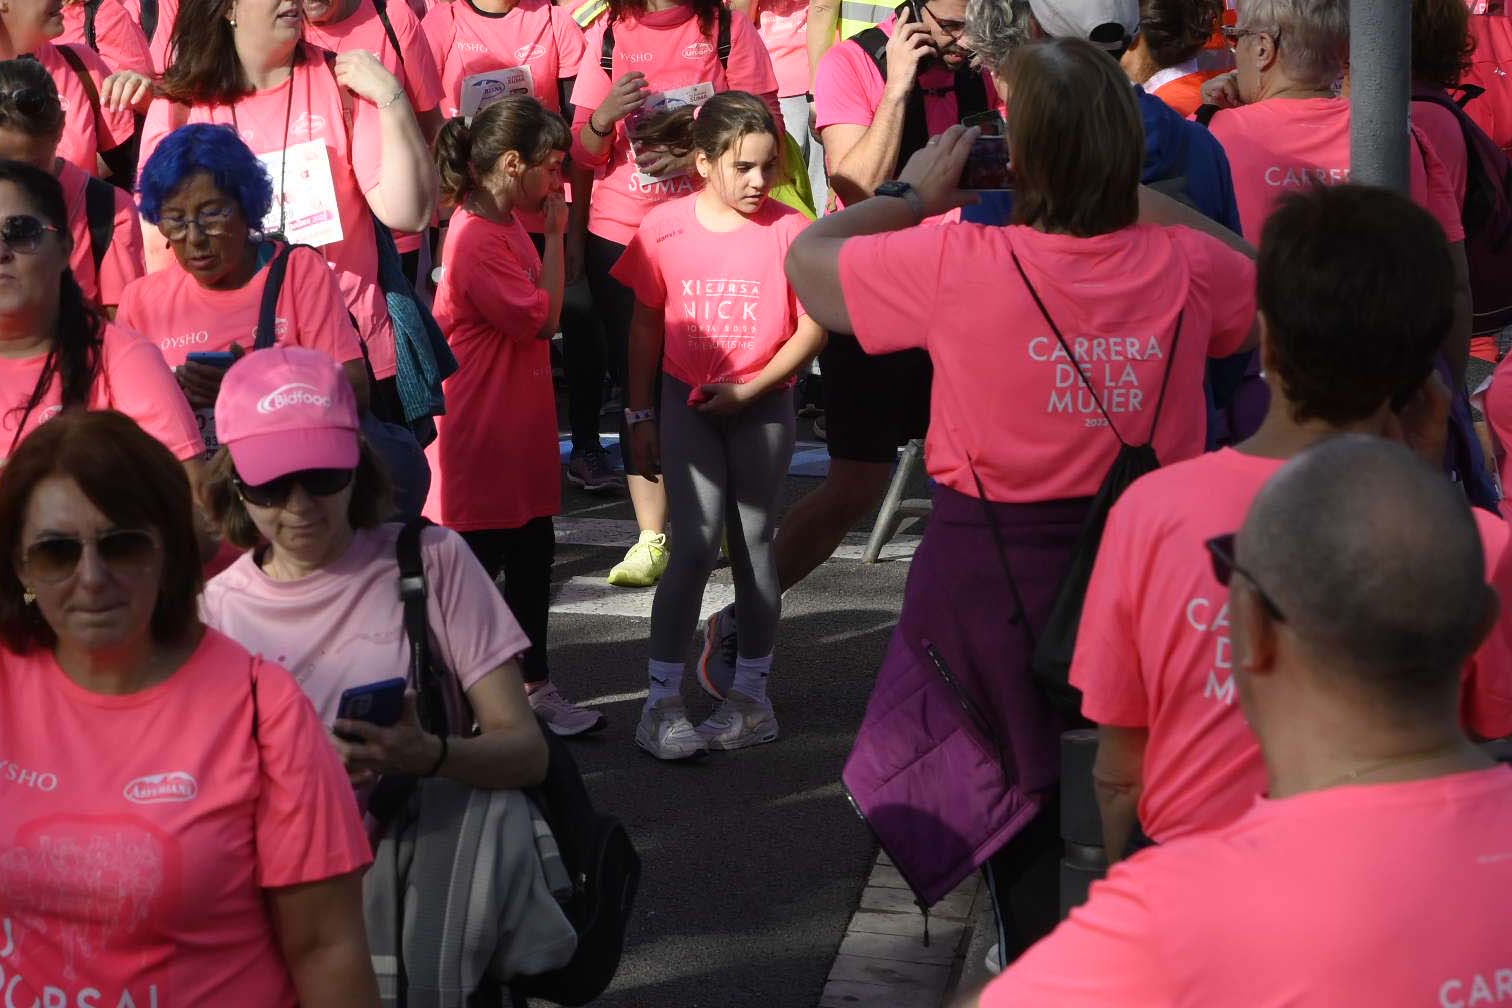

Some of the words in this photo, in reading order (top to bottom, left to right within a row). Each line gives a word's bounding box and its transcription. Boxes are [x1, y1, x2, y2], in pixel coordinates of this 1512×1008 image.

[628, 172, 693, 194] SUMA
[682, 279, 701, 296] XI
[705, 282, 760, 294] CURSA
[684, 301, 759, 321] NICK
[161, 330, 209, 351] OYSHO
[1028, 335, 1163, 361] CARRERA
[1055, 363, 1093, 388] DE
[1105, 362, 1139, 387] LA
[1047, 389, 1144, 414] MUJER
